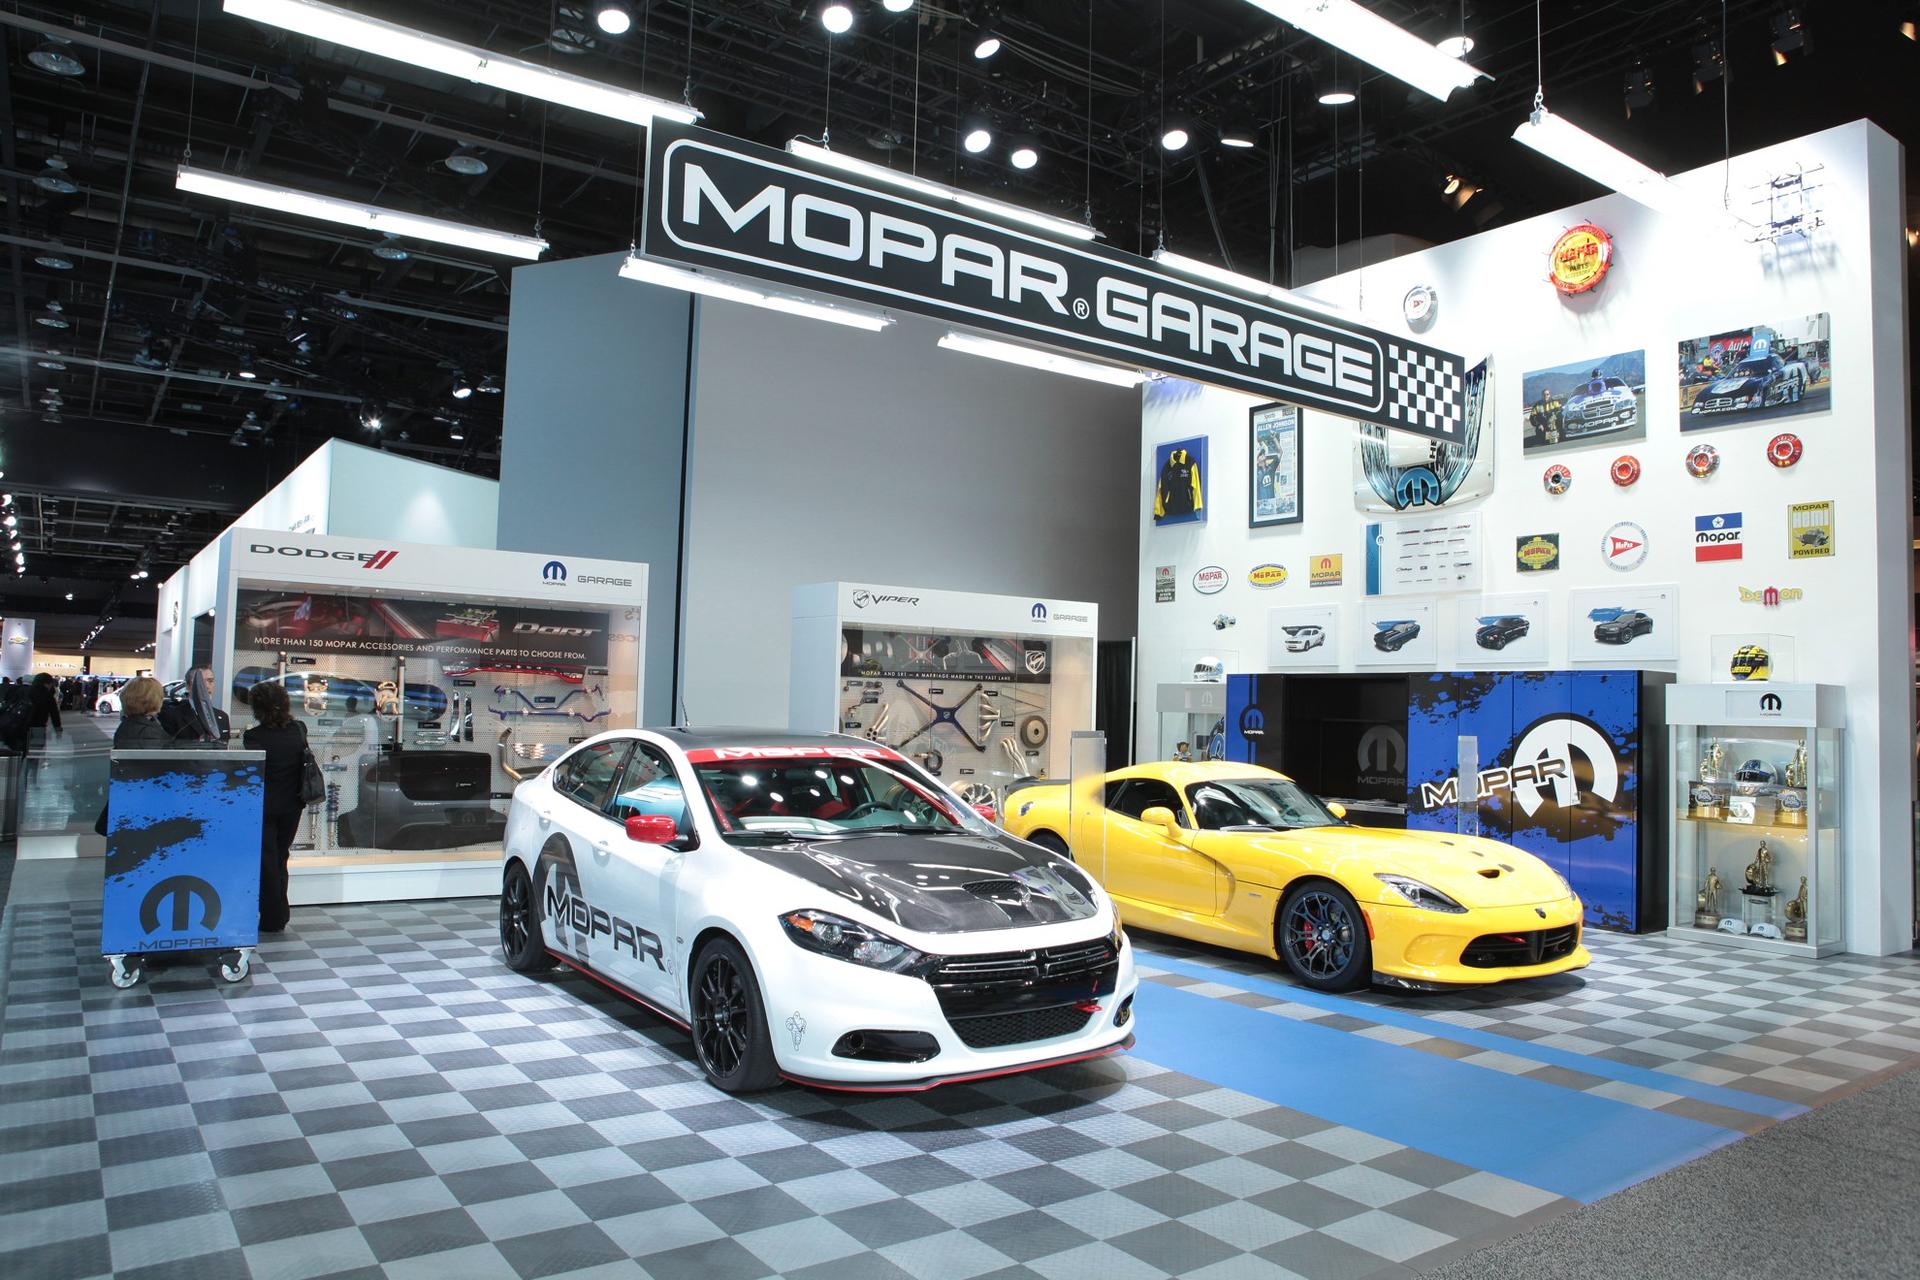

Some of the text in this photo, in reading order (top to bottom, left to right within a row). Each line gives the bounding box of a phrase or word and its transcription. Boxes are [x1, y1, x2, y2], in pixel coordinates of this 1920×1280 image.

[1097, 276, 1373, 397] GARAGE
[1577, 416, 1620, 429] MOPAR
[1792, 503, 1829, 512] MOPAR
[250, 544, 379, 563] DODGE
[1793, 547, 1830, 556] POWERED
[577, 575, 633, 587] GARAGE
[1311, 571, 1341, 579] MOPAR
[871, 594, 920, 607] VIPER
[1053, 613, 1088, 622] GARAGE
[254, 637, 281, 645] MORE
[283, 638, 306, 647] THAN
[309, 639, 323, 647] 150
[325, 640, 357, 649] MOPAR
[359, 641, 414, 651] ACCESSORIES
[437, 646, 494, 656] PERFORMANCE
[495, 649, 518, 657] PARTS
[531, 650, 562, 659] CHOOSE
[1357, 775, 1405, 786] MOPAR
[1421, 757, 1568, 808] MPAR
[547, 885, 666, 972] MOPAR
[139, 937, 219, 950] MOPAR
